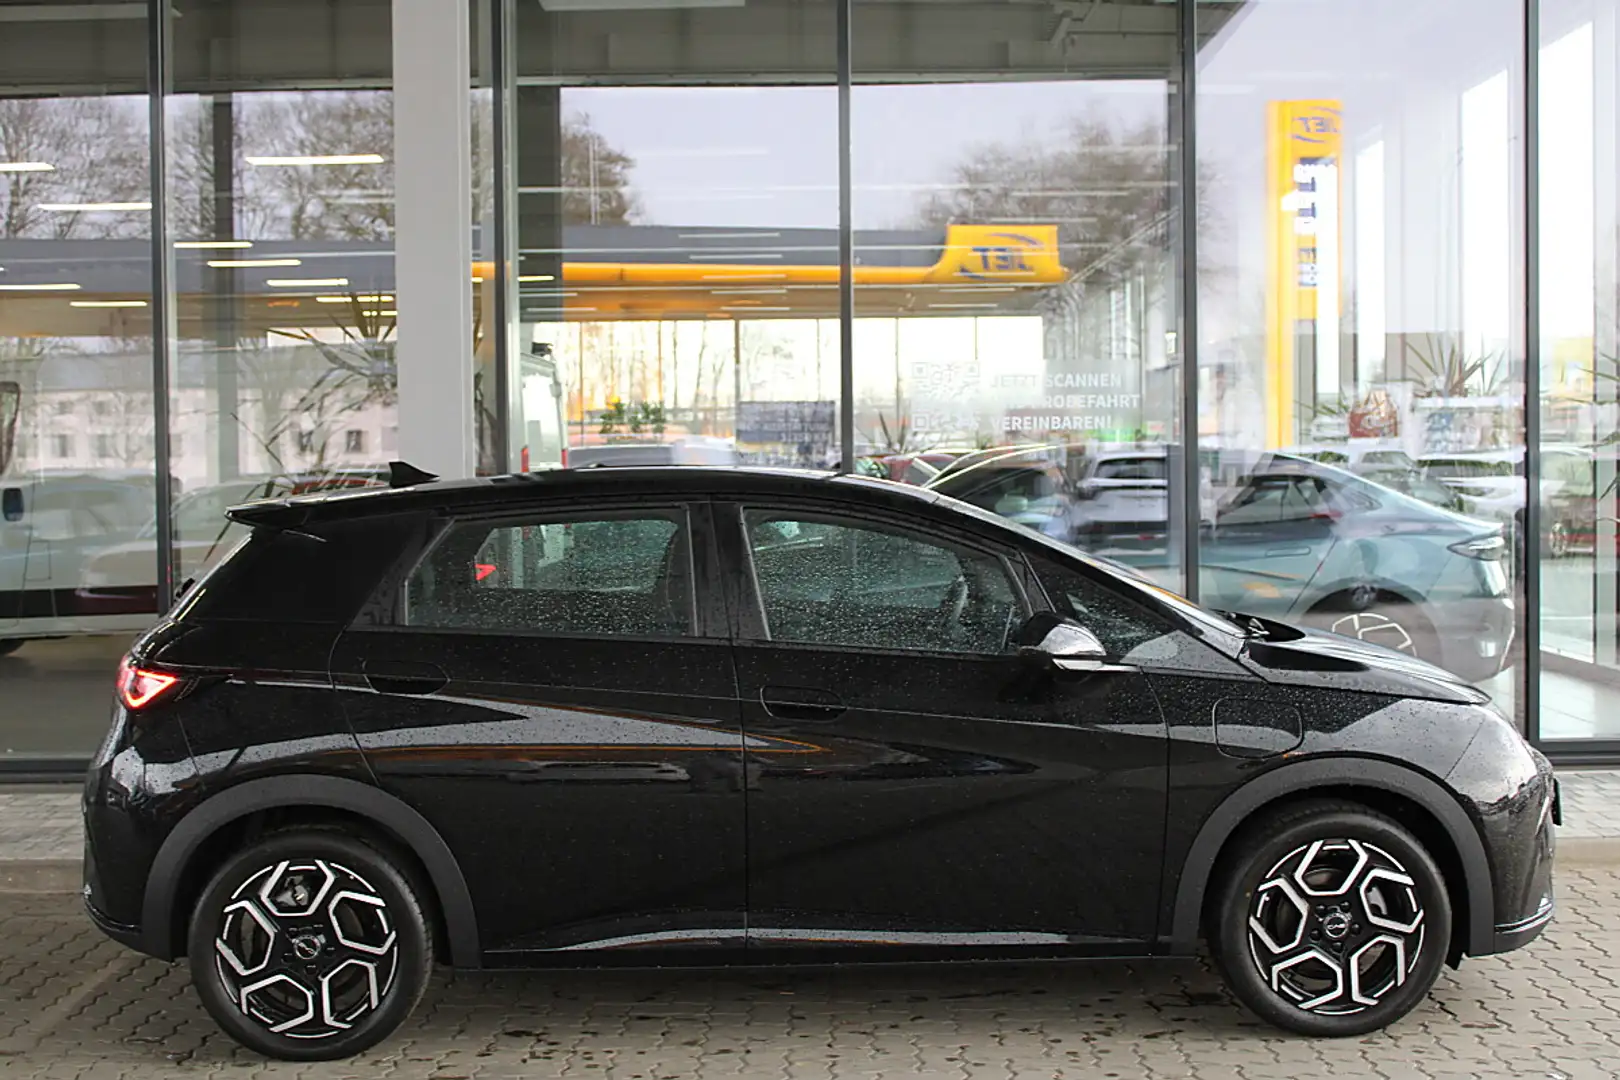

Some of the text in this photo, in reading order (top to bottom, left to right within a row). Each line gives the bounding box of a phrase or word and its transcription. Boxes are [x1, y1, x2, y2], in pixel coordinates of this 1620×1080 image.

[1045, 372, 1122, 388] SCANNEN
[1034, 393, 1140, 409] ROBEFAHRT
[991, 414, 1112, 431] VEREINBAREN!
